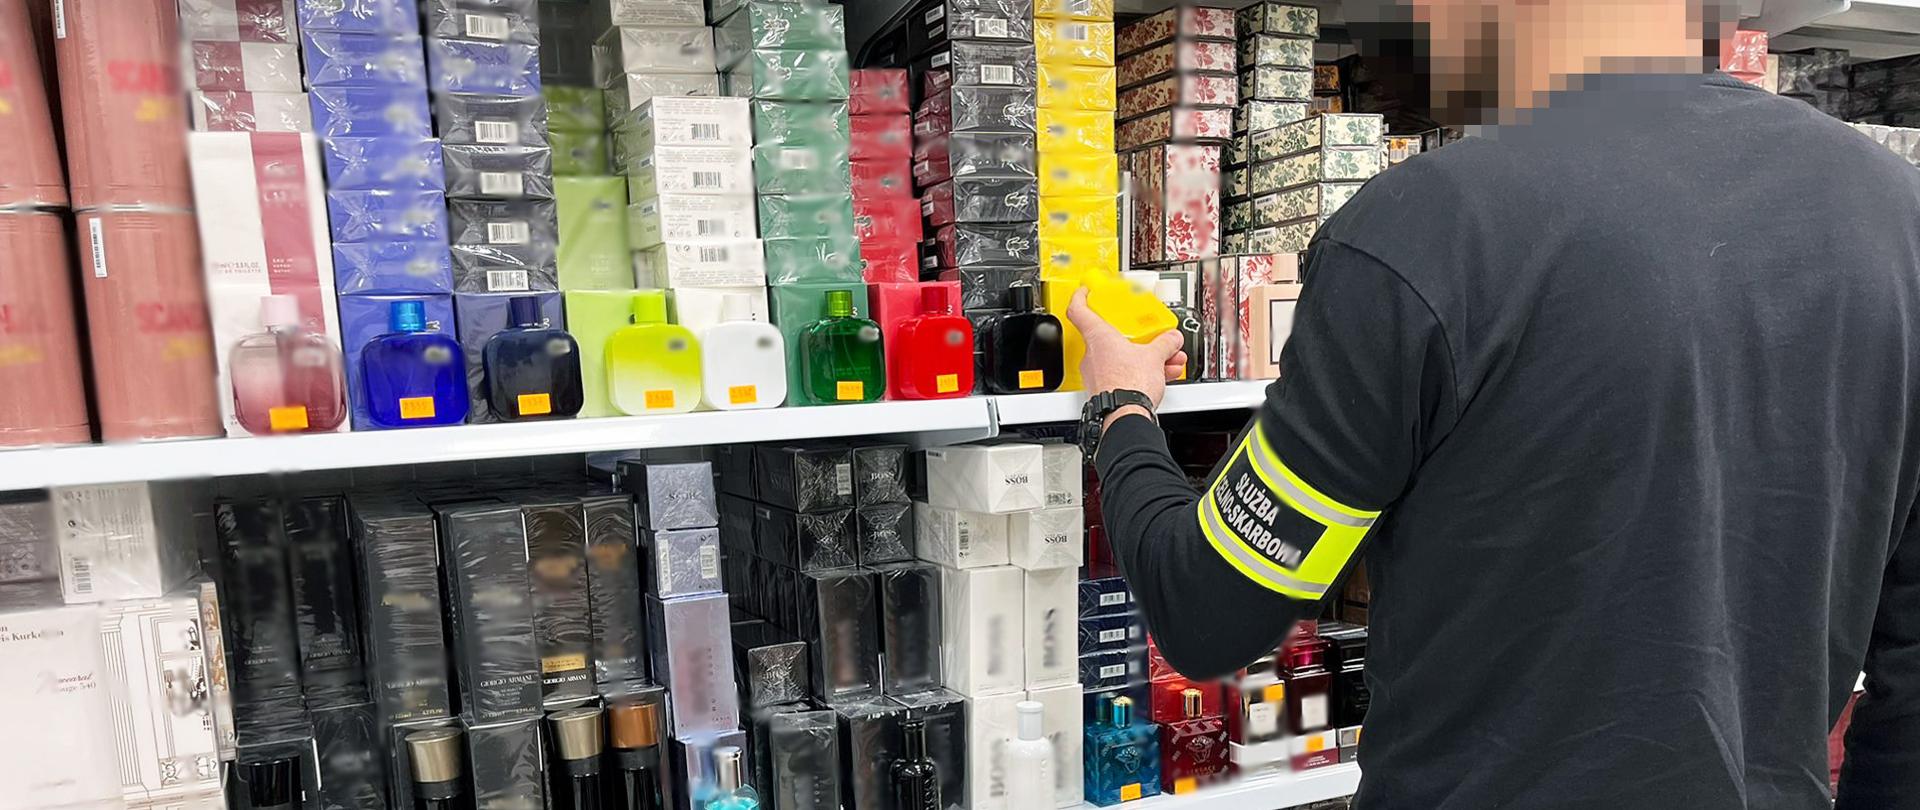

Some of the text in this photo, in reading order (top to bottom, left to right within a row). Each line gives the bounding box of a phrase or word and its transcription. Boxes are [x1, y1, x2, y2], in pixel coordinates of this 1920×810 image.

[1004, 475, 1028, 486] BOSS
[1235, 472, 1279, 527] SŁUŻBA
[1045, 535, 1068, 544] BOSS
[480, 678, 507, 687] GIORGIO
[543, 674, 587, 685] GIORGIO ARMANI
